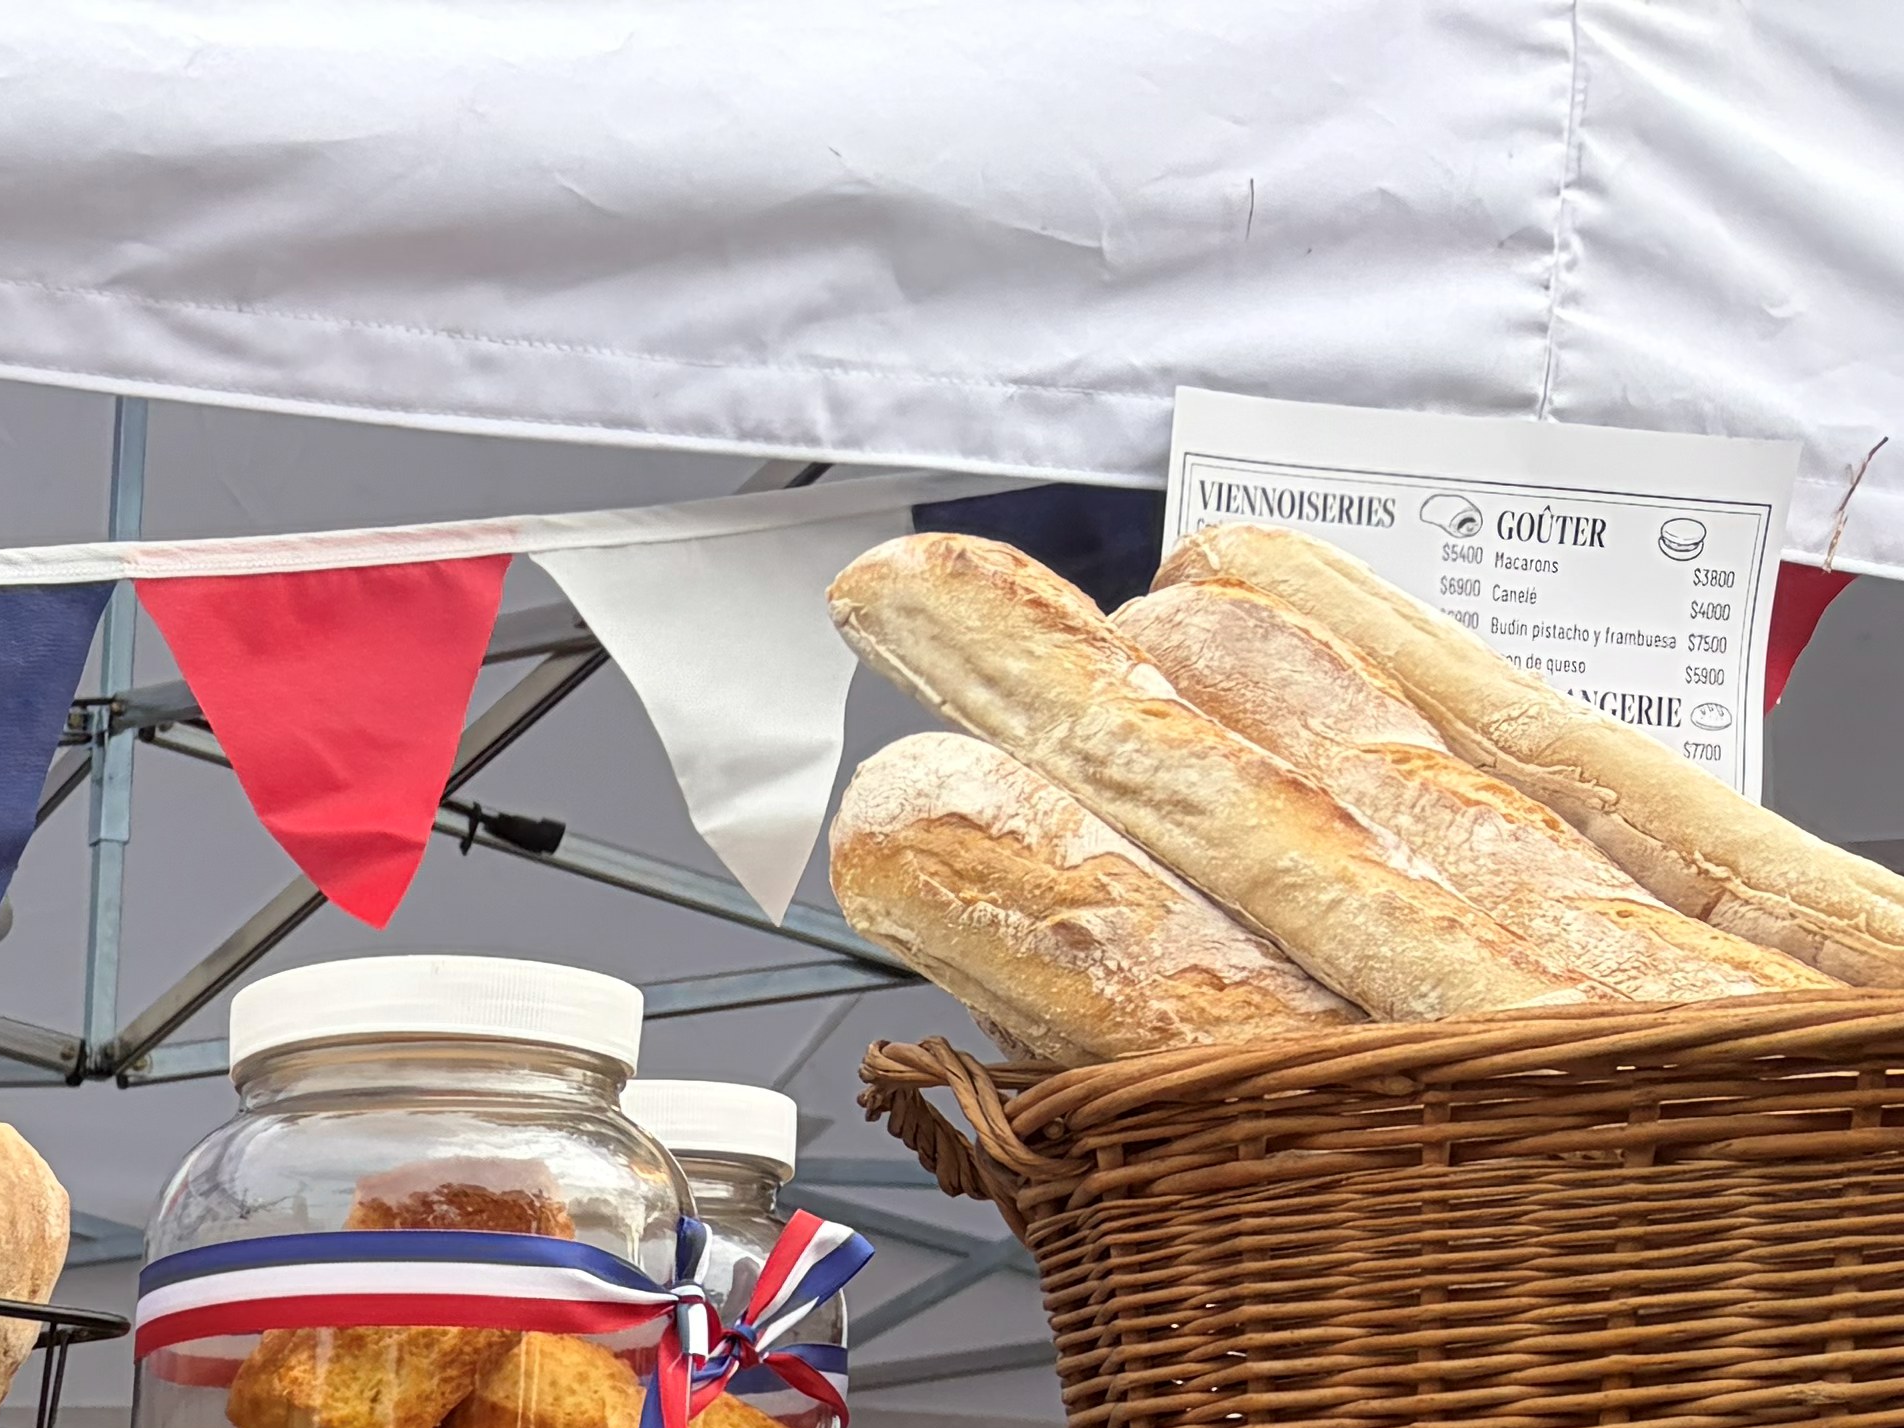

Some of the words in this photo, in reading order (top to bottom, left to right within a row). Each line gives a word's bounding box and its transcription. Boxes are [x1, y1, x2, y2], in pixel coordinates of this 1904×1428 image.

[1197, 479, 1396, 528] VIENNOISERIES
[1497, 504, 1607, 548] GOÛTER
[1442, 542, 1483, 565] $5400
[1494, 551, 1559, 574] Macarons
[1693, 567, 1735, 588] $3800
[1440, 575, 1481, 597] $6900
[1492, 584, 1537, 605] Canelé
[1690, 600, 1731, 621] $4000
[1440, 607, 1479, 629] 900
[1532, 621, 1589, 642] pistacho
[1593, 629, 1601, 648] y
[1605, 627, 1677, 649] frambuesa
[1687, 634, 1727, 654] $7500
[1526, 653, 1542, 670] de
[1546, 657, 1586, 676] queso
[1685, 665, 1725, 686] $5900
[1683, 741, 1722, 761] $7700
